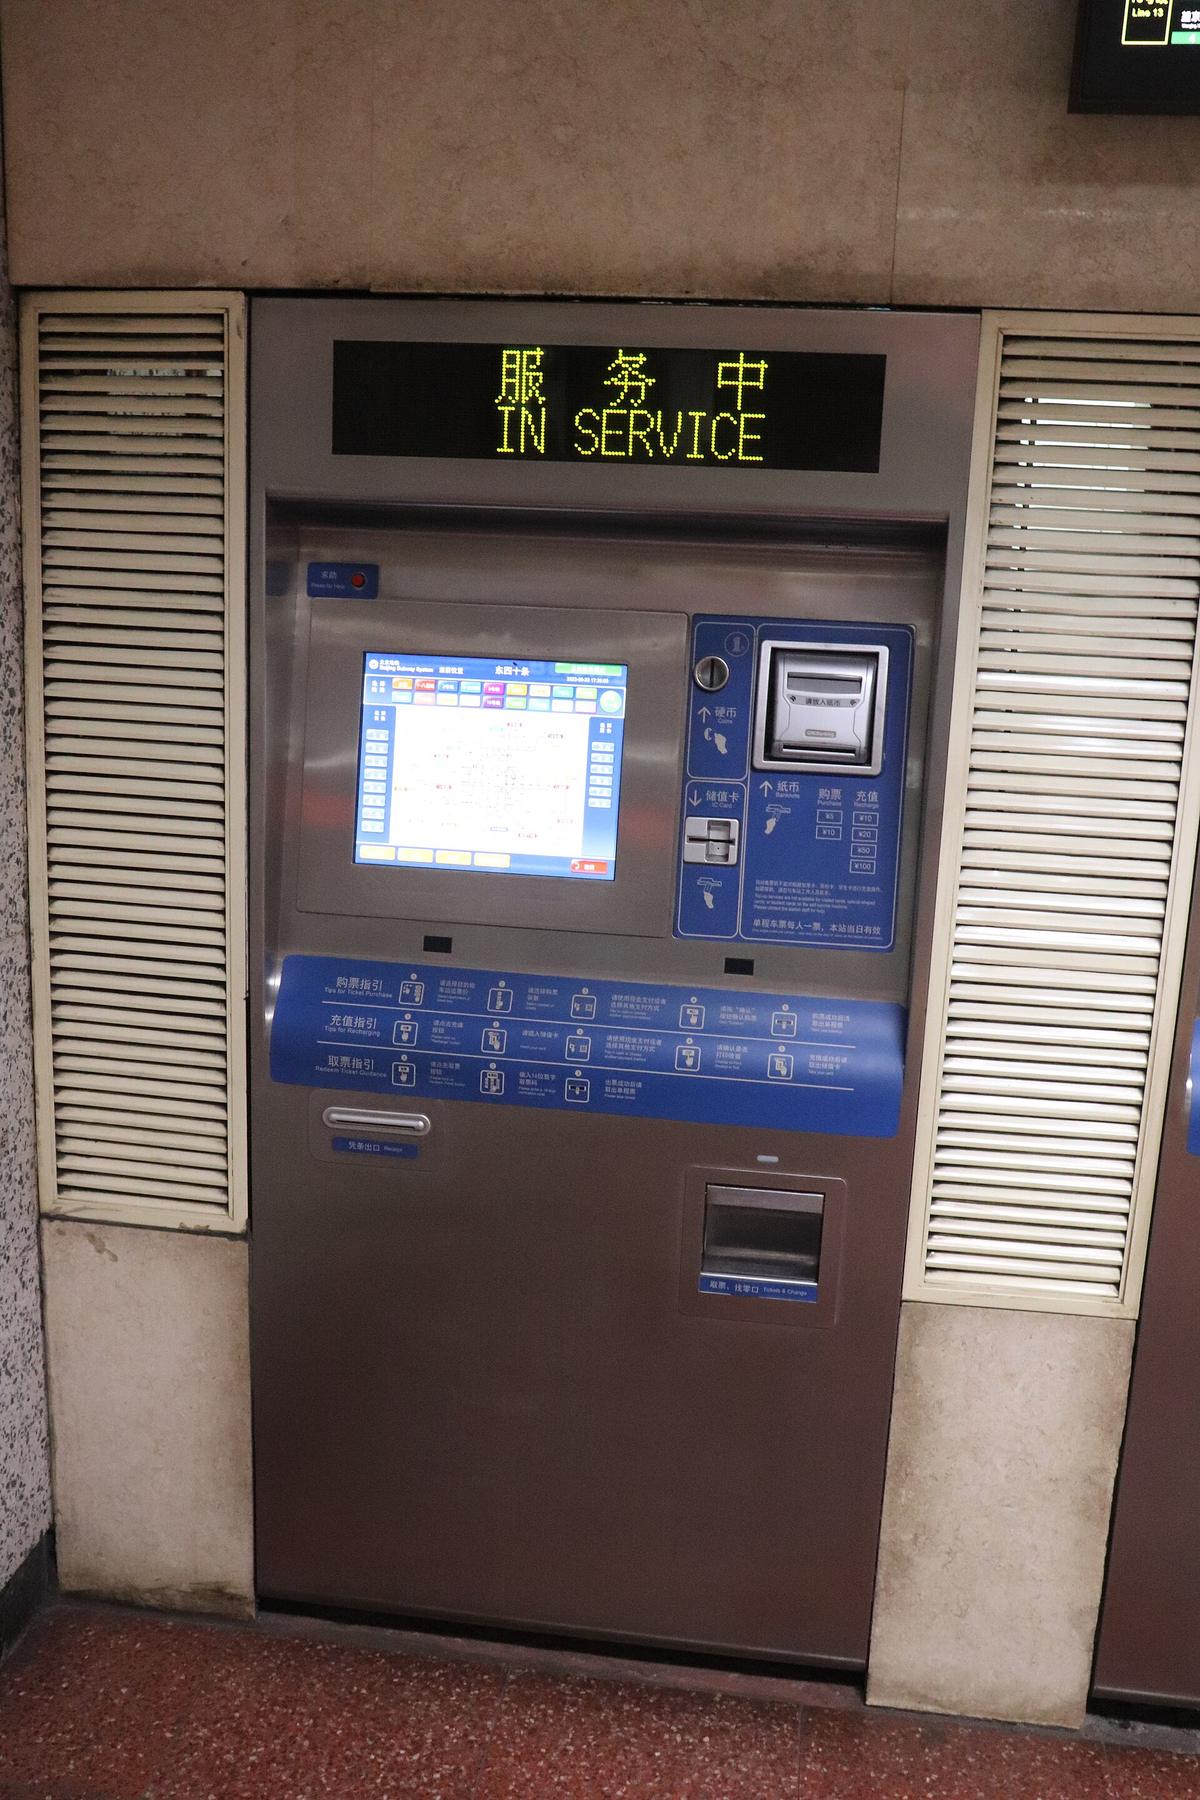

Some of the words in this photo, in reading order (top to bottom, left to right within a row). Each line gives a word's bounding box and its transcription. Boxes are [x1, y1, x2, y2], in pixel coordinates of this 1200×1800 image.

[497, 407, 545, 453] IN
[574, 409, 765, 461] SERVICE
[714, 706, 736, 718] 硬币
[777, 781, 800, 792] 纸币
[706, 790, 740, 803] 储值卡
[818, 788, 841, 800] 购票
[856, 790, 879, 802] 充值
[336, 976, 383, 991] 购票指引
[330, 1015, 376, 1030] 充值指引
[328, 1055, 374, 1070] 取票指引
